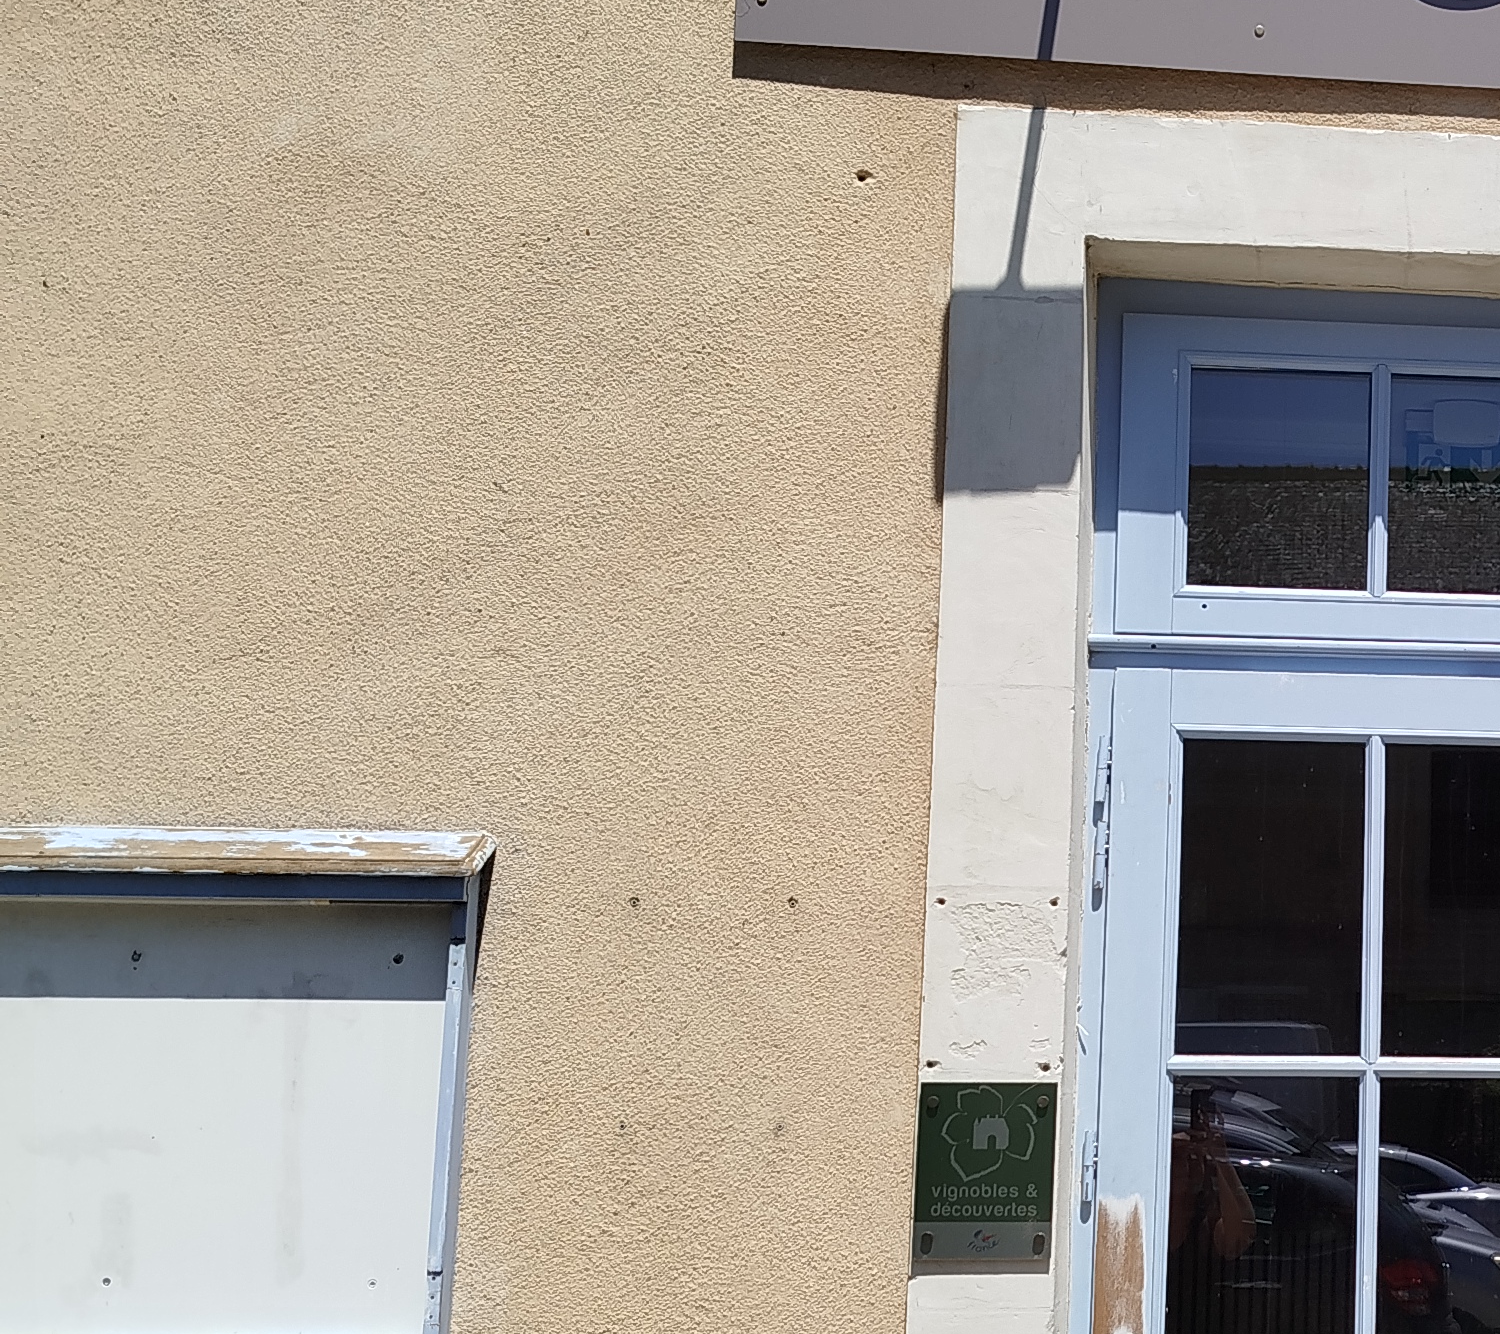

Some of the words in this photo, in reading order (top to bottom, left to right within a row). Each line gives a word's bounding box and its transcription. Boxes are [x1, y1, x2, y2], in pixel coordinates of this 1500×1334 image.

[932, 1183, 1019, 1201] vignobles
[1026, 1183, 1038, 1198] &
[931, 1202, 1037, 1217] découvertes
